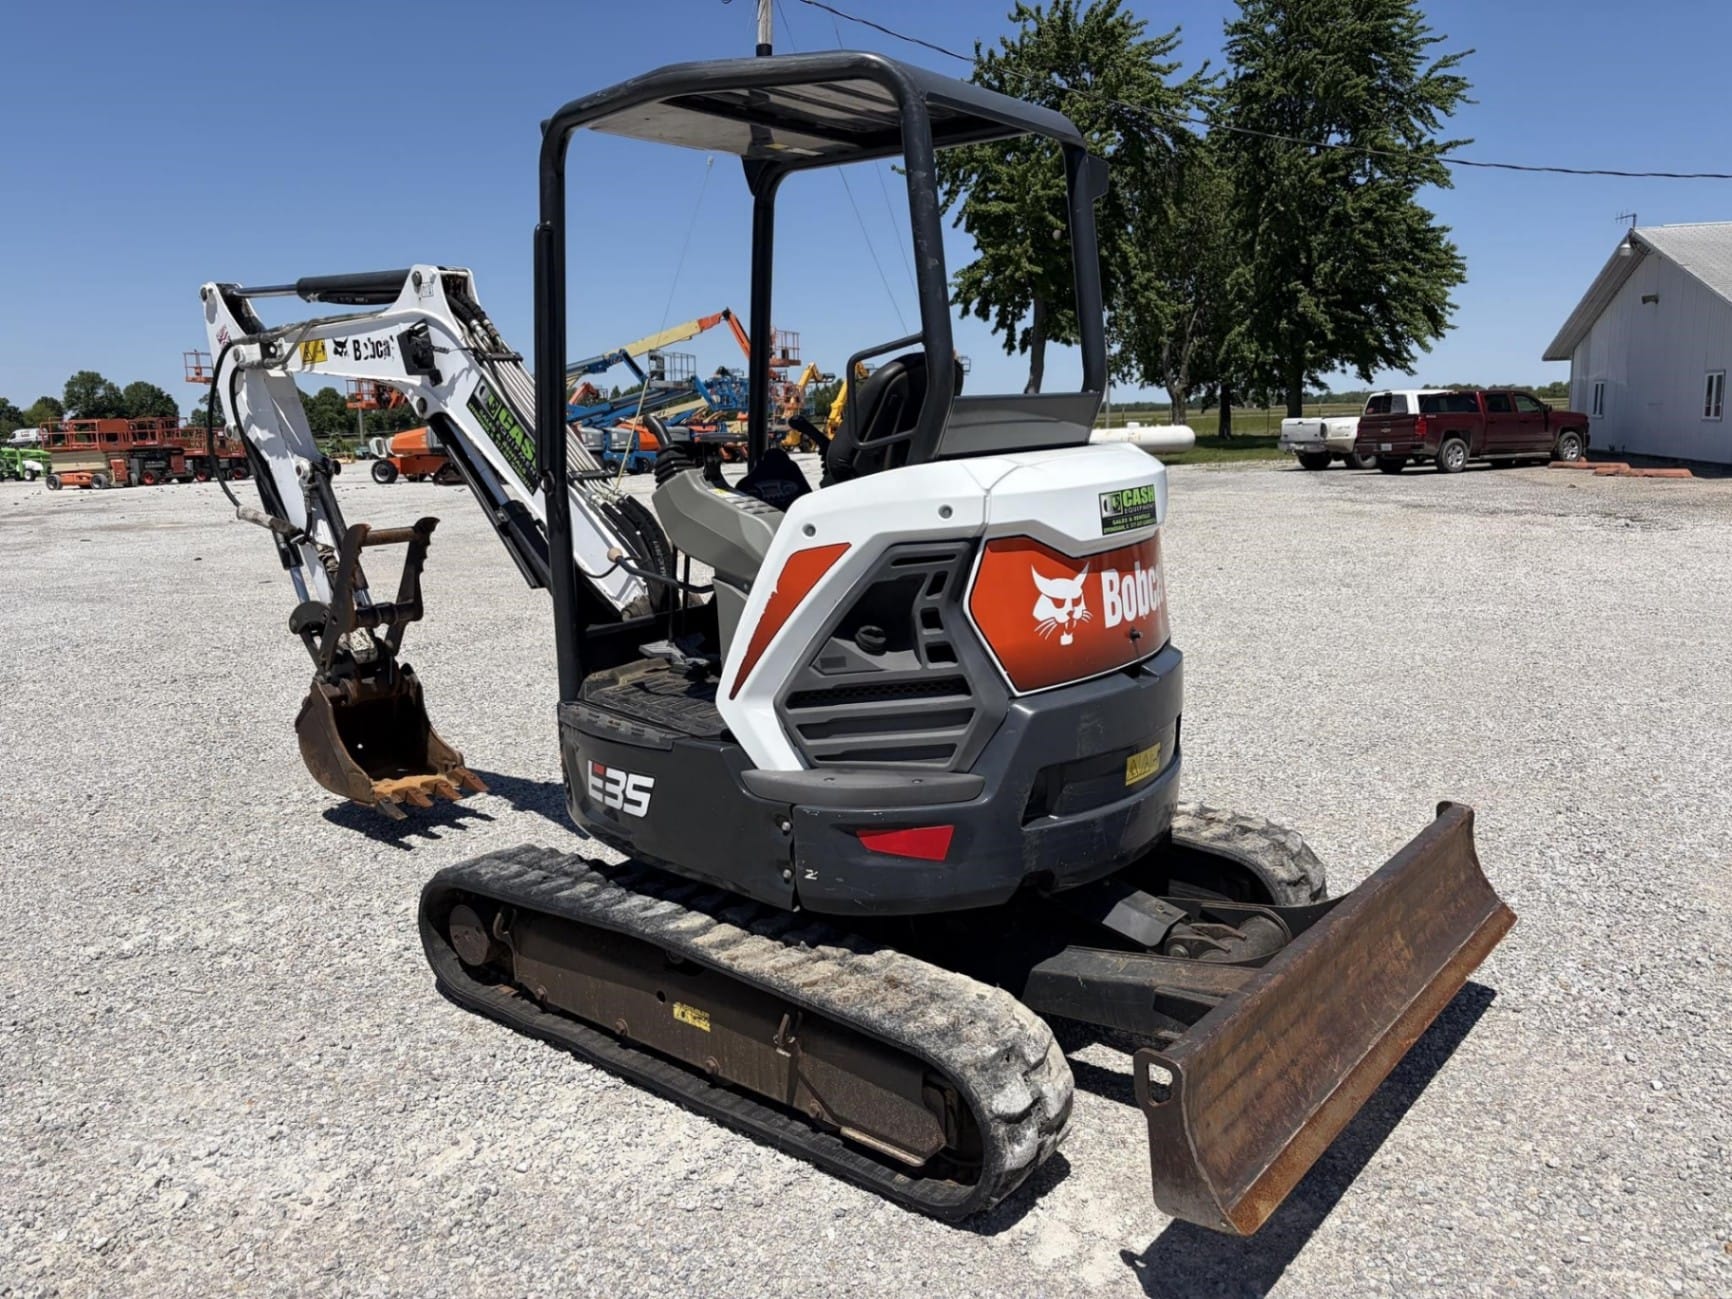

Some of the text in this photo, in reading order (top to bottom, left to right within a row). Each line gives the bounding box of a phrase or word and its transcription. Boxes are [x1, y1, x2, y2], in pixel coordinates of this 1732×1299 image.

[498, 408, 537, 469] CAS
[1122, 486, 1154, 507] CASH
[588, 760, 655, 818] E35
